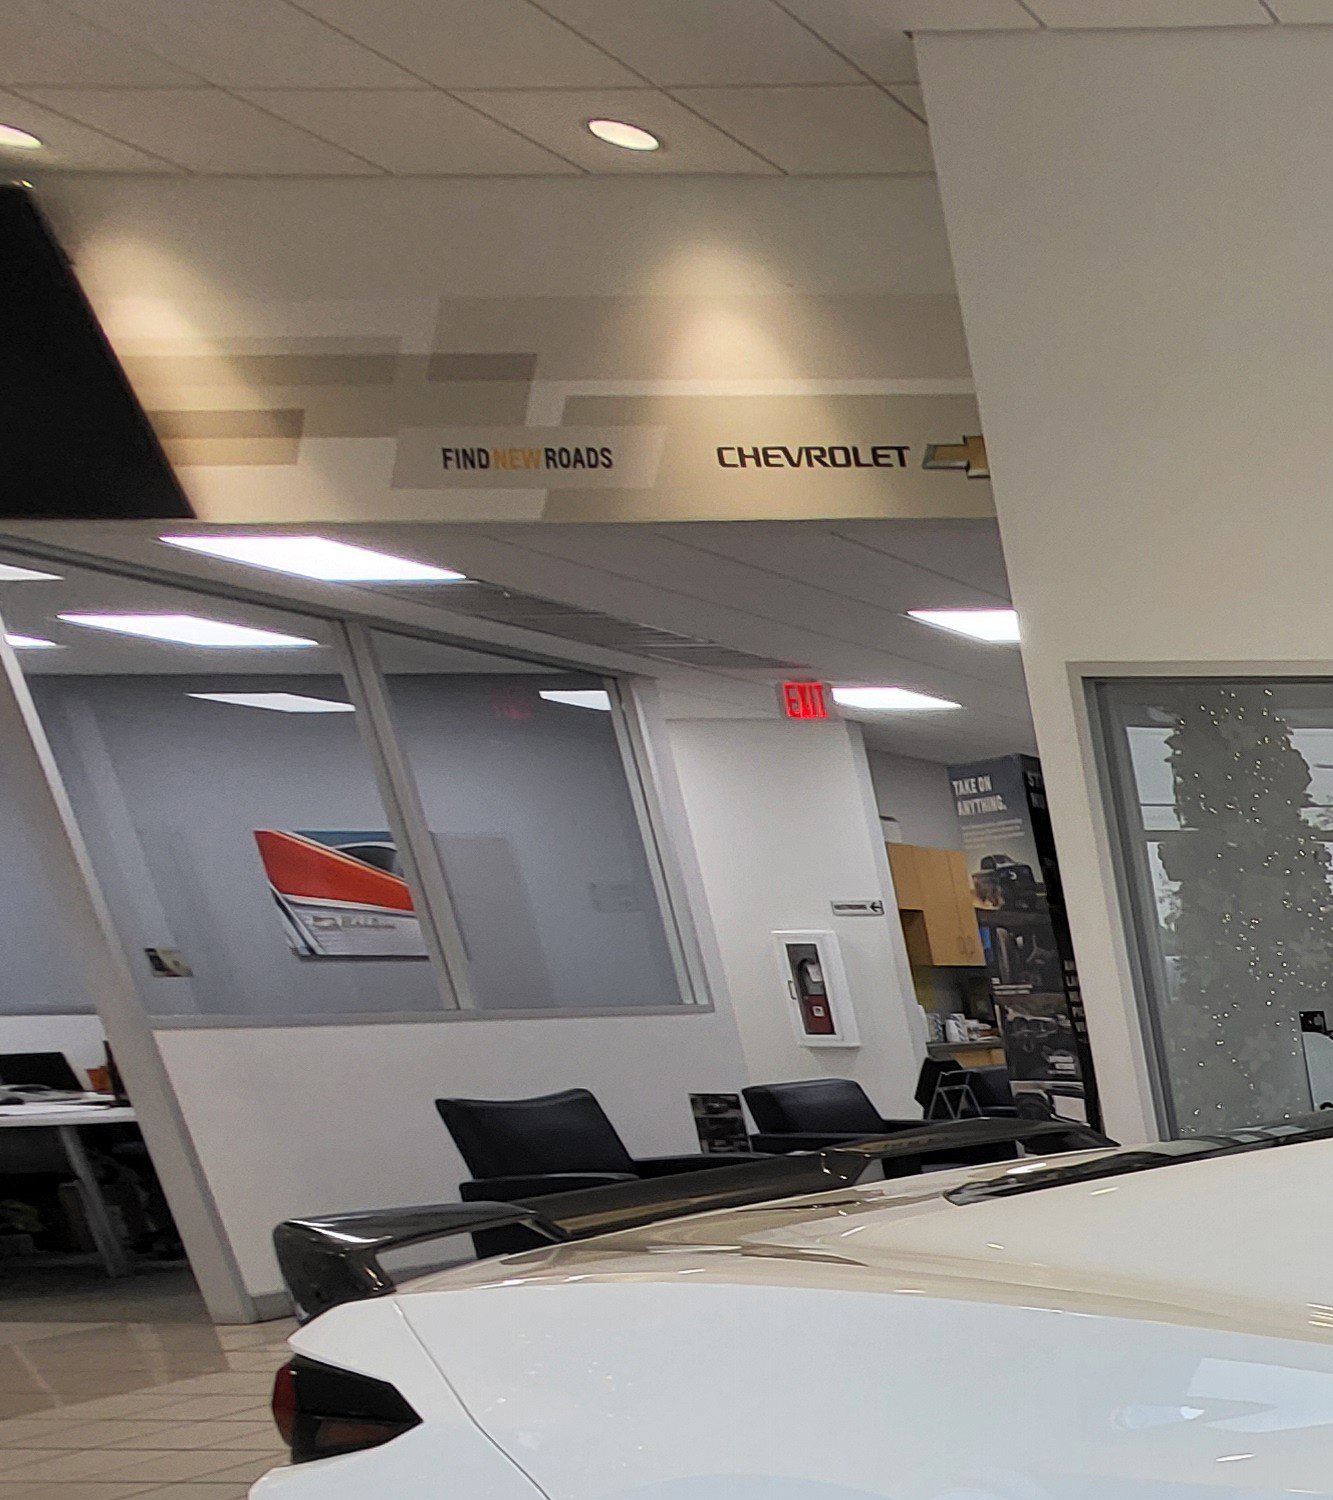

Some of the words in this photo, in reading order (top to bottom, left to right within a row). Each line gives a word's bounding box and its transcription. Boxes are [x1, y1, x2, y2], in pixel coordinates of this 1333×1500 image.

[442, 447, 490, 469] FIND
[492, 448, 542, 470] NEW
[544, 447, 613, 469] ROADS
[716, 446, 910, 468] CHEVROLET
[784, 683, 828, 719] EXIT
[952, 777, 978, 796] TAKE
[978, 775, 992, 792] ON
[957, 795, 1007, 816] ANYTHING.
